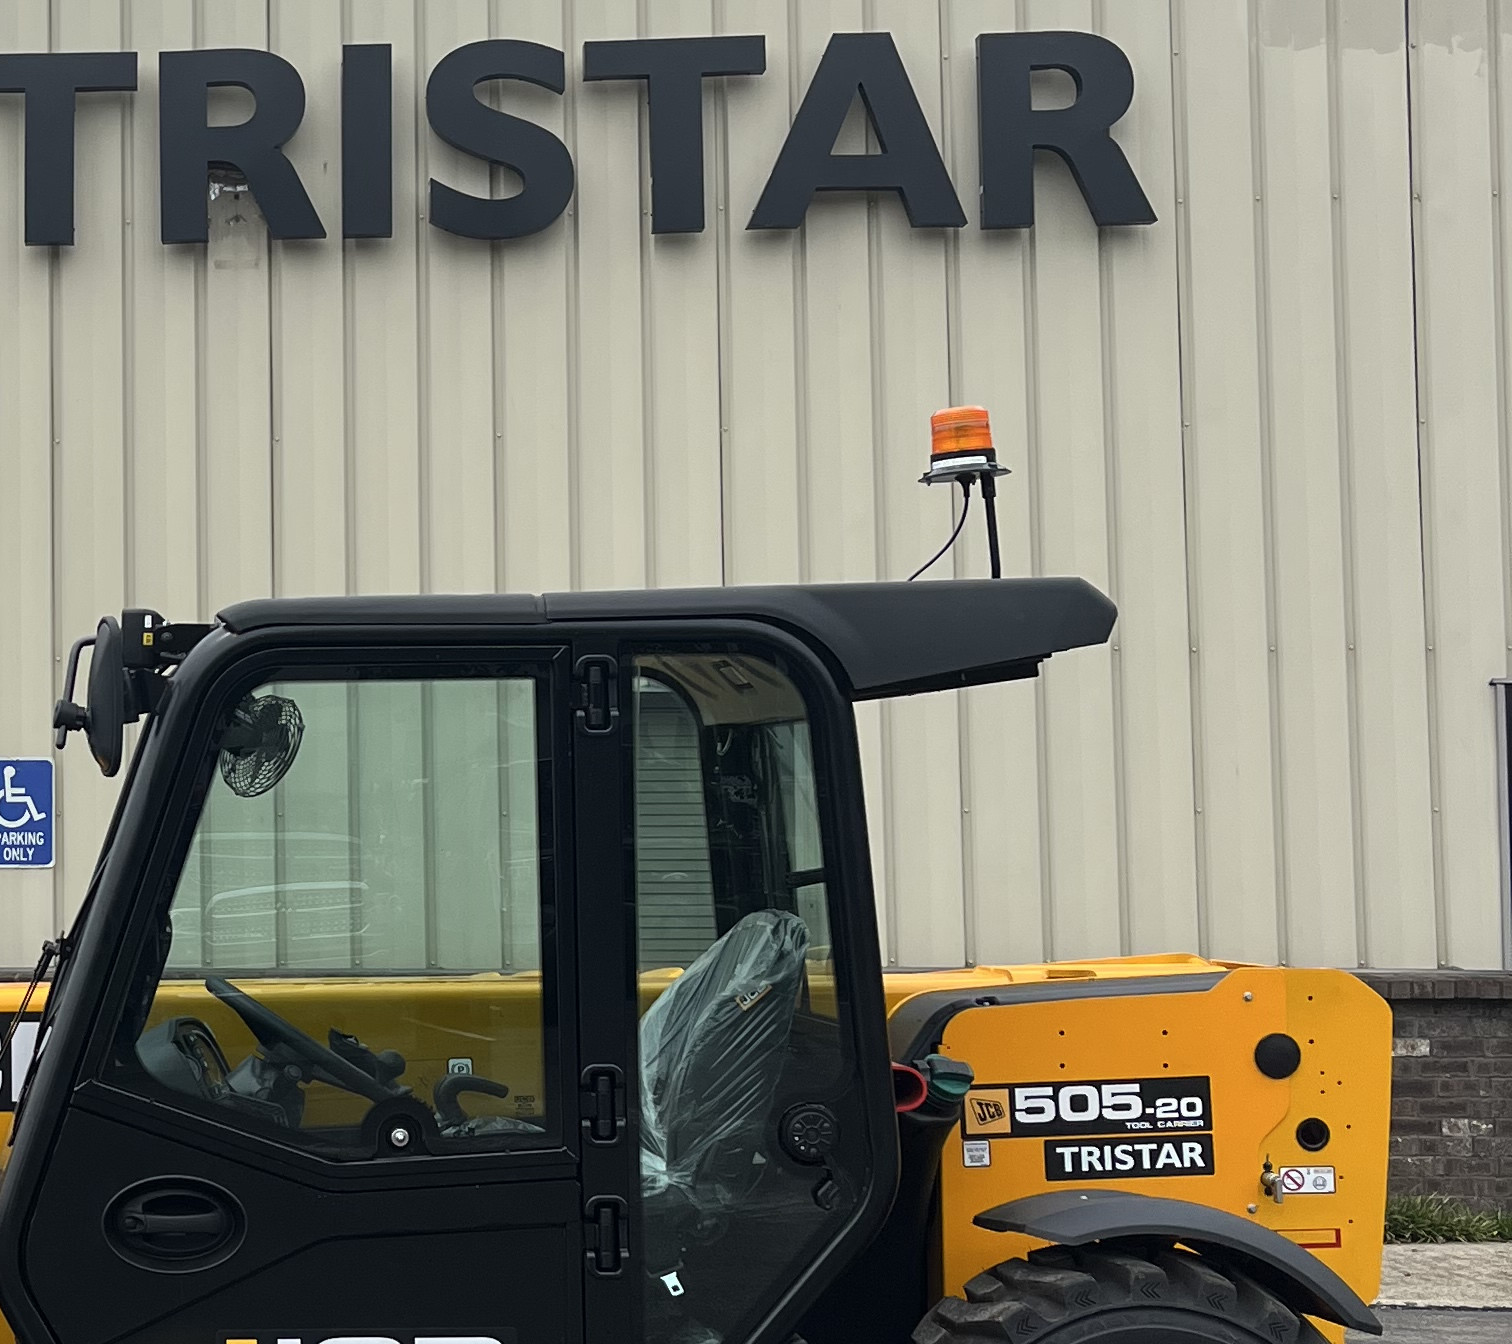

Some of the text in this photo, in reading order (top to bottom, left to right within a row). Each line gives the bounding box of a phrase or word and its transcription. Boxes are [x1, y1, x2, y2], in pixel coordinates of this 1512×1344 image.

[3, 847, 35, 861] ONLY
[976, 1101, 1003, 1122] JCB
[1014, 1083, 1203, 1123] 505-20
[1125, 1121, 1153, 1129] TOOL
[1055, 1142, 1205, 1173] TRISTAR
